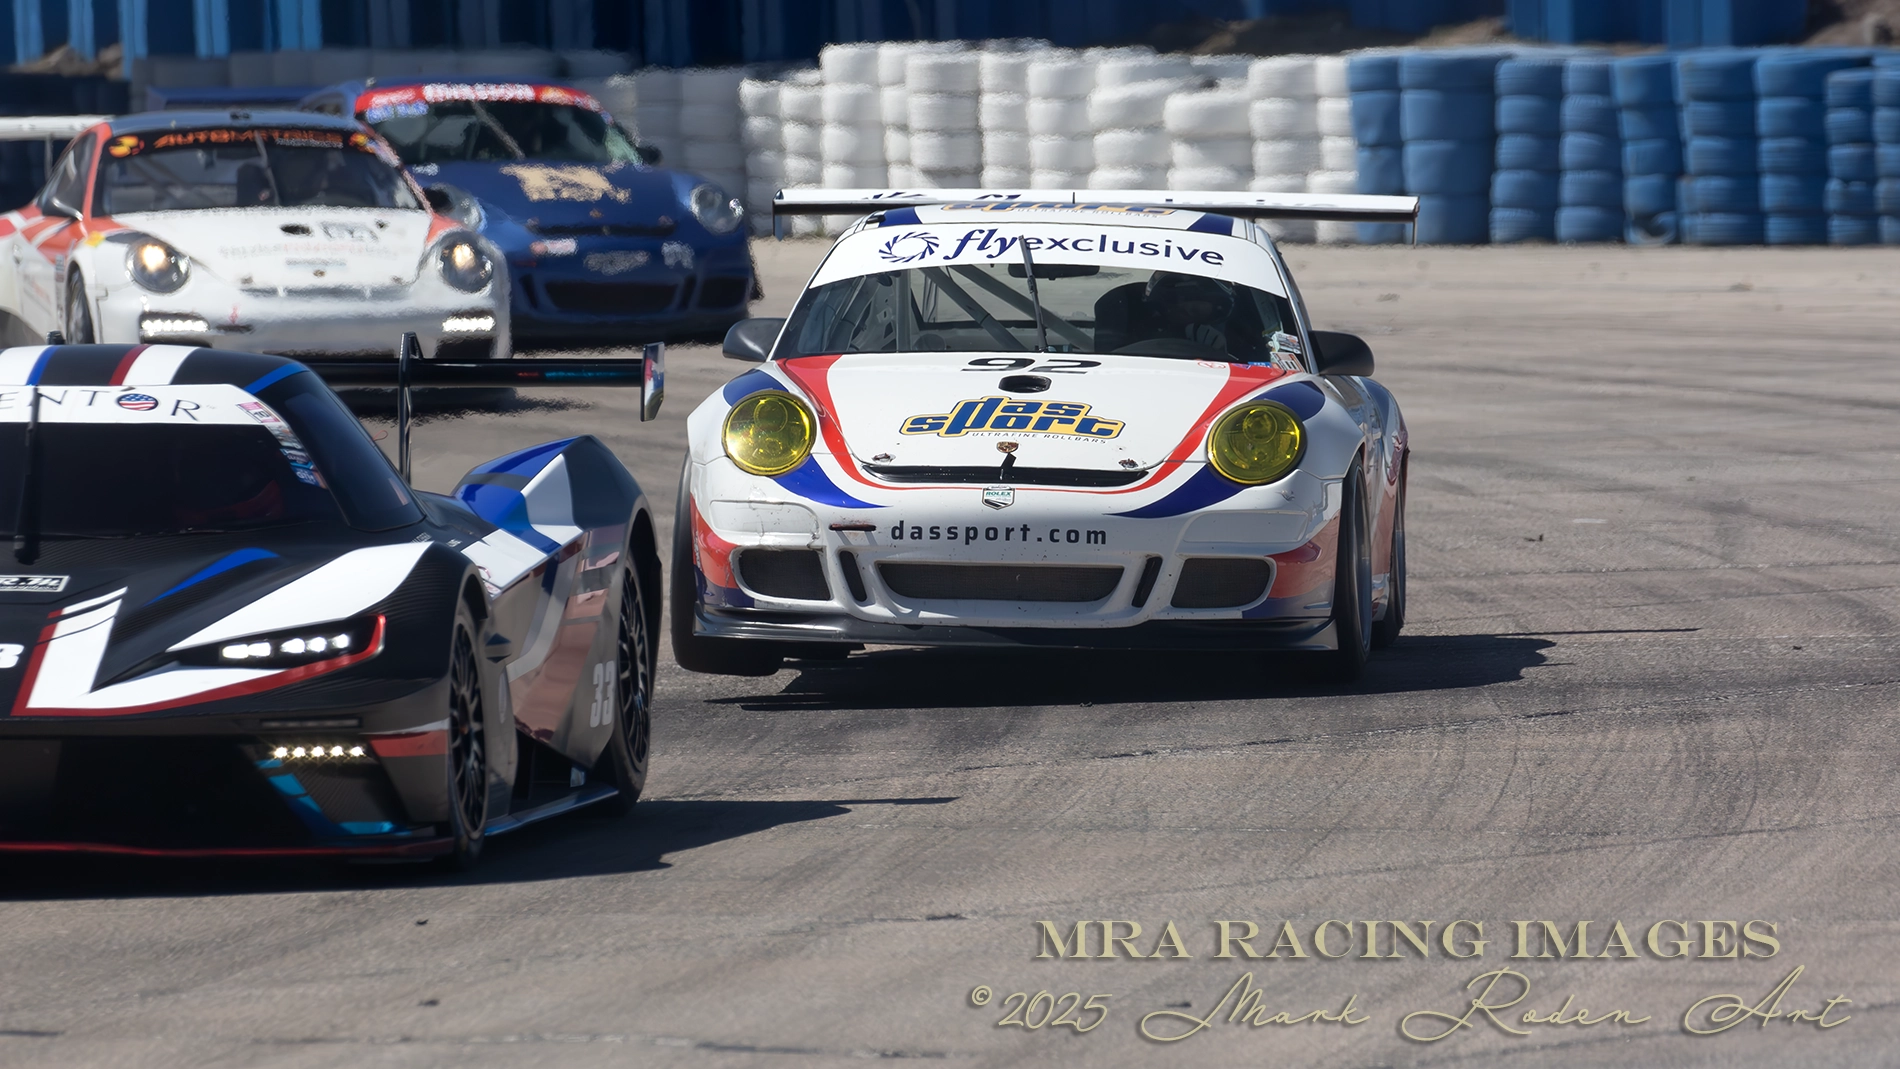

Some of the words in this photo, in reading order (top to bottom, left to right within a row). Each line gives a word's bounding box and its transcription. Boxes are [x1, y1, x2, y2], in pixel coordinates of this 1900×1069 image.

[943, 228, 1225, 265] flyexclusive
[961, 357, 1102, 374] 92
[1043, 434, 1106, 444] ROLLBARS
[891, 520, 1107, 545] dassport.com
[590, 660, 615, 728] 33
